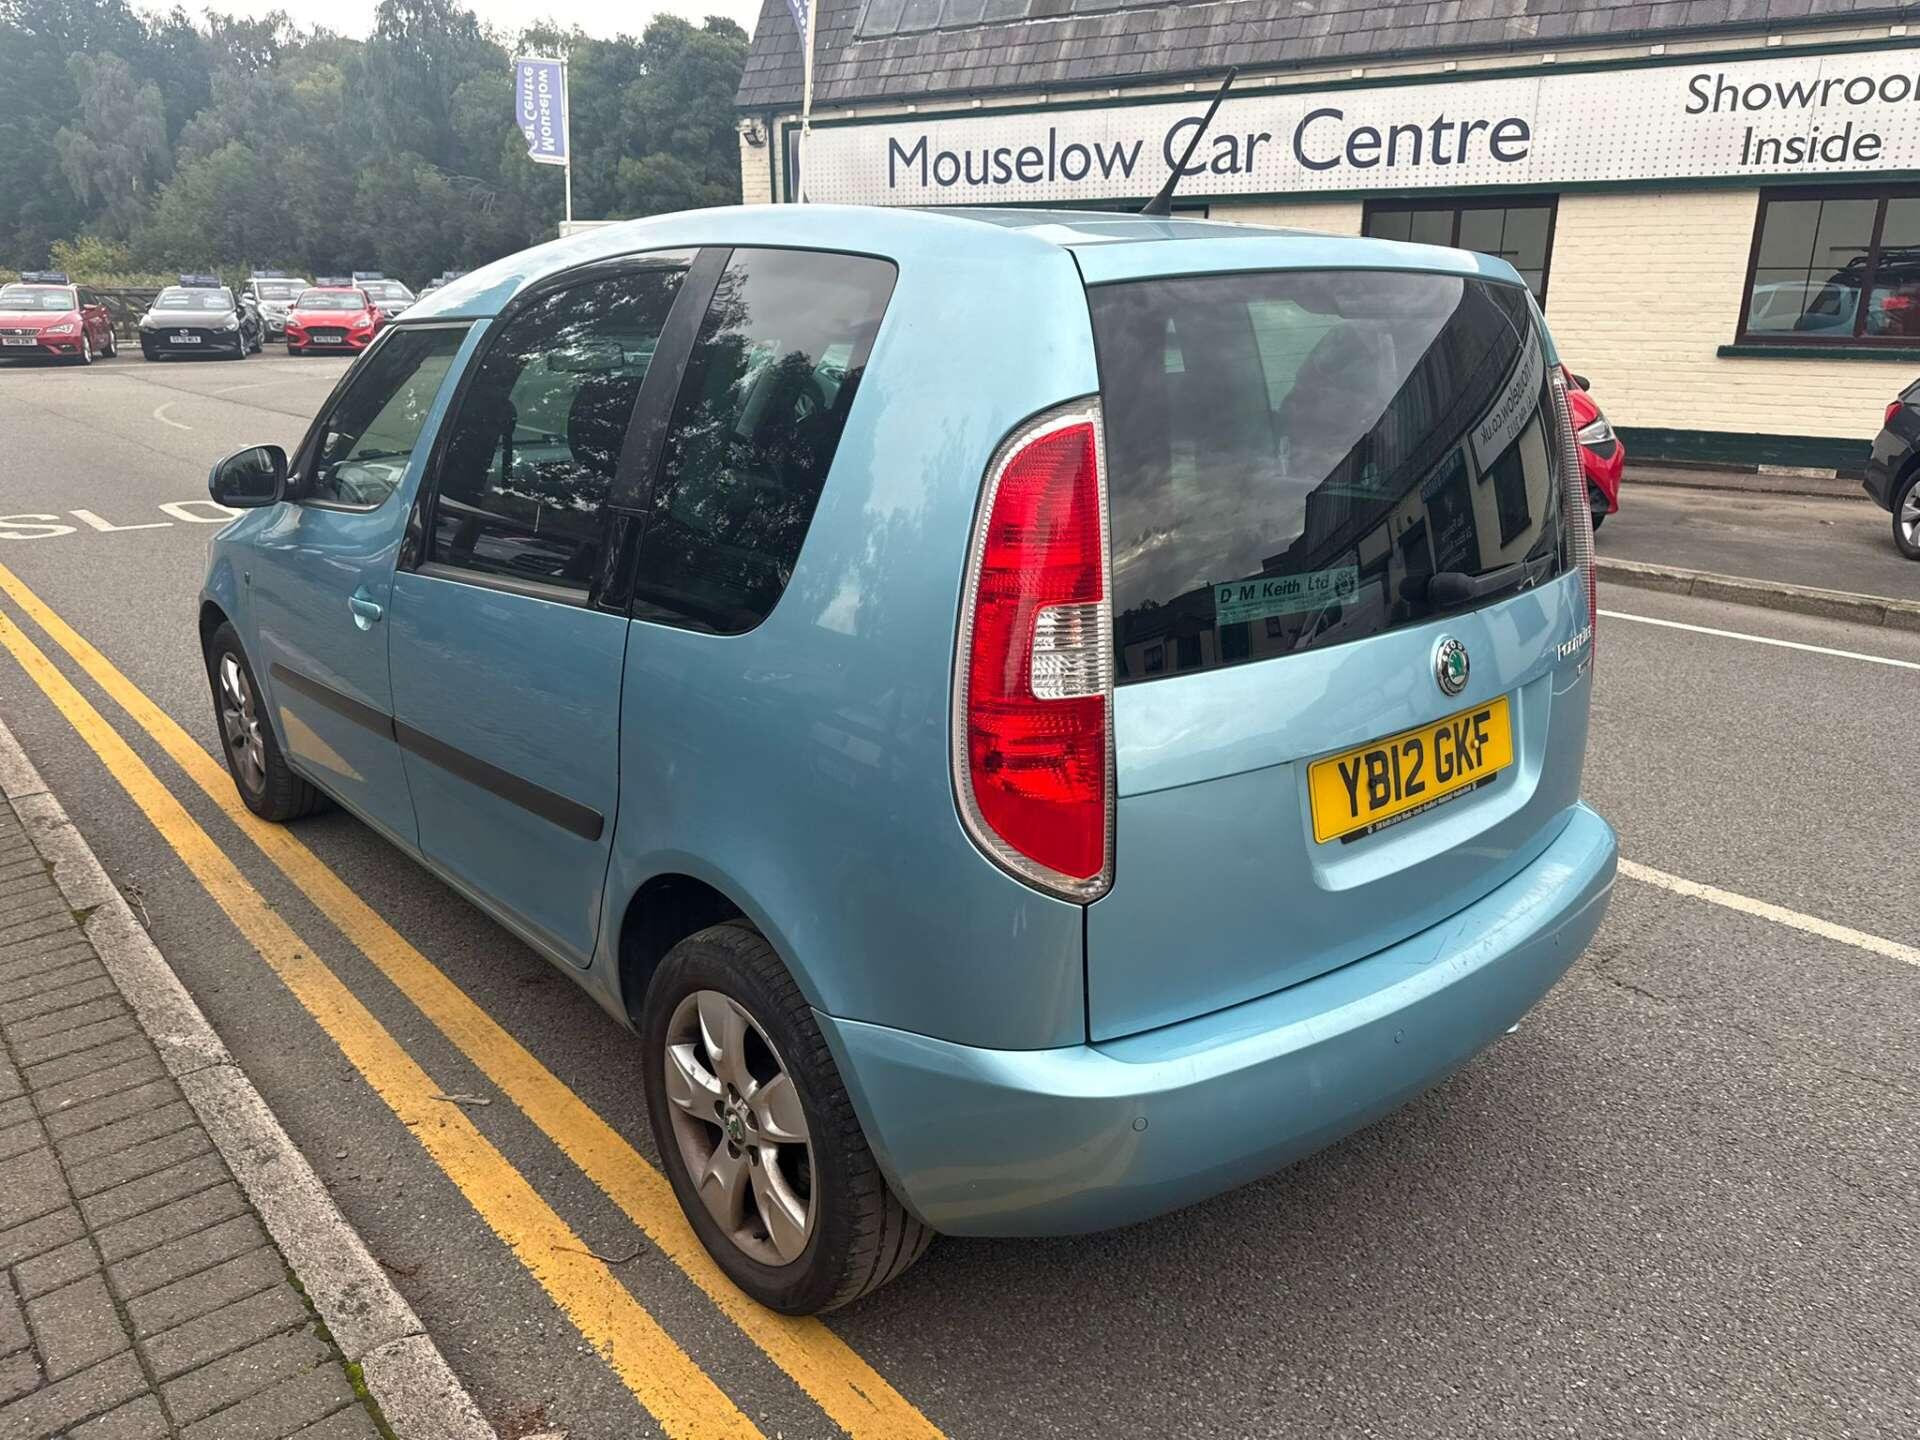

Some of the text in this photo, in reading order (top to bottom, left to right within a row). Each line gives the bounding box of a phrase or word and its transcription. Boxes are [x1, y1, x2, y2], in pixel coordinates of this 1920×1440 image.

[1685, 73, 1920, 115] Showroo
[888, 108, 1531, 188] Mouselow Car Centre
[1740, 121, 1882, 166] Inside
[0, 500, 248, 540] SLO
[1220, 588, 1232, 604] D
[1239, 585, 1255, 601] M
[1262, 579, 1300, 598] Keith
[1307, 574, 1330, 591] Ltd
[1338, 739, 1426, 818] YB12
[1434, 710, 1491, 784] GKF
